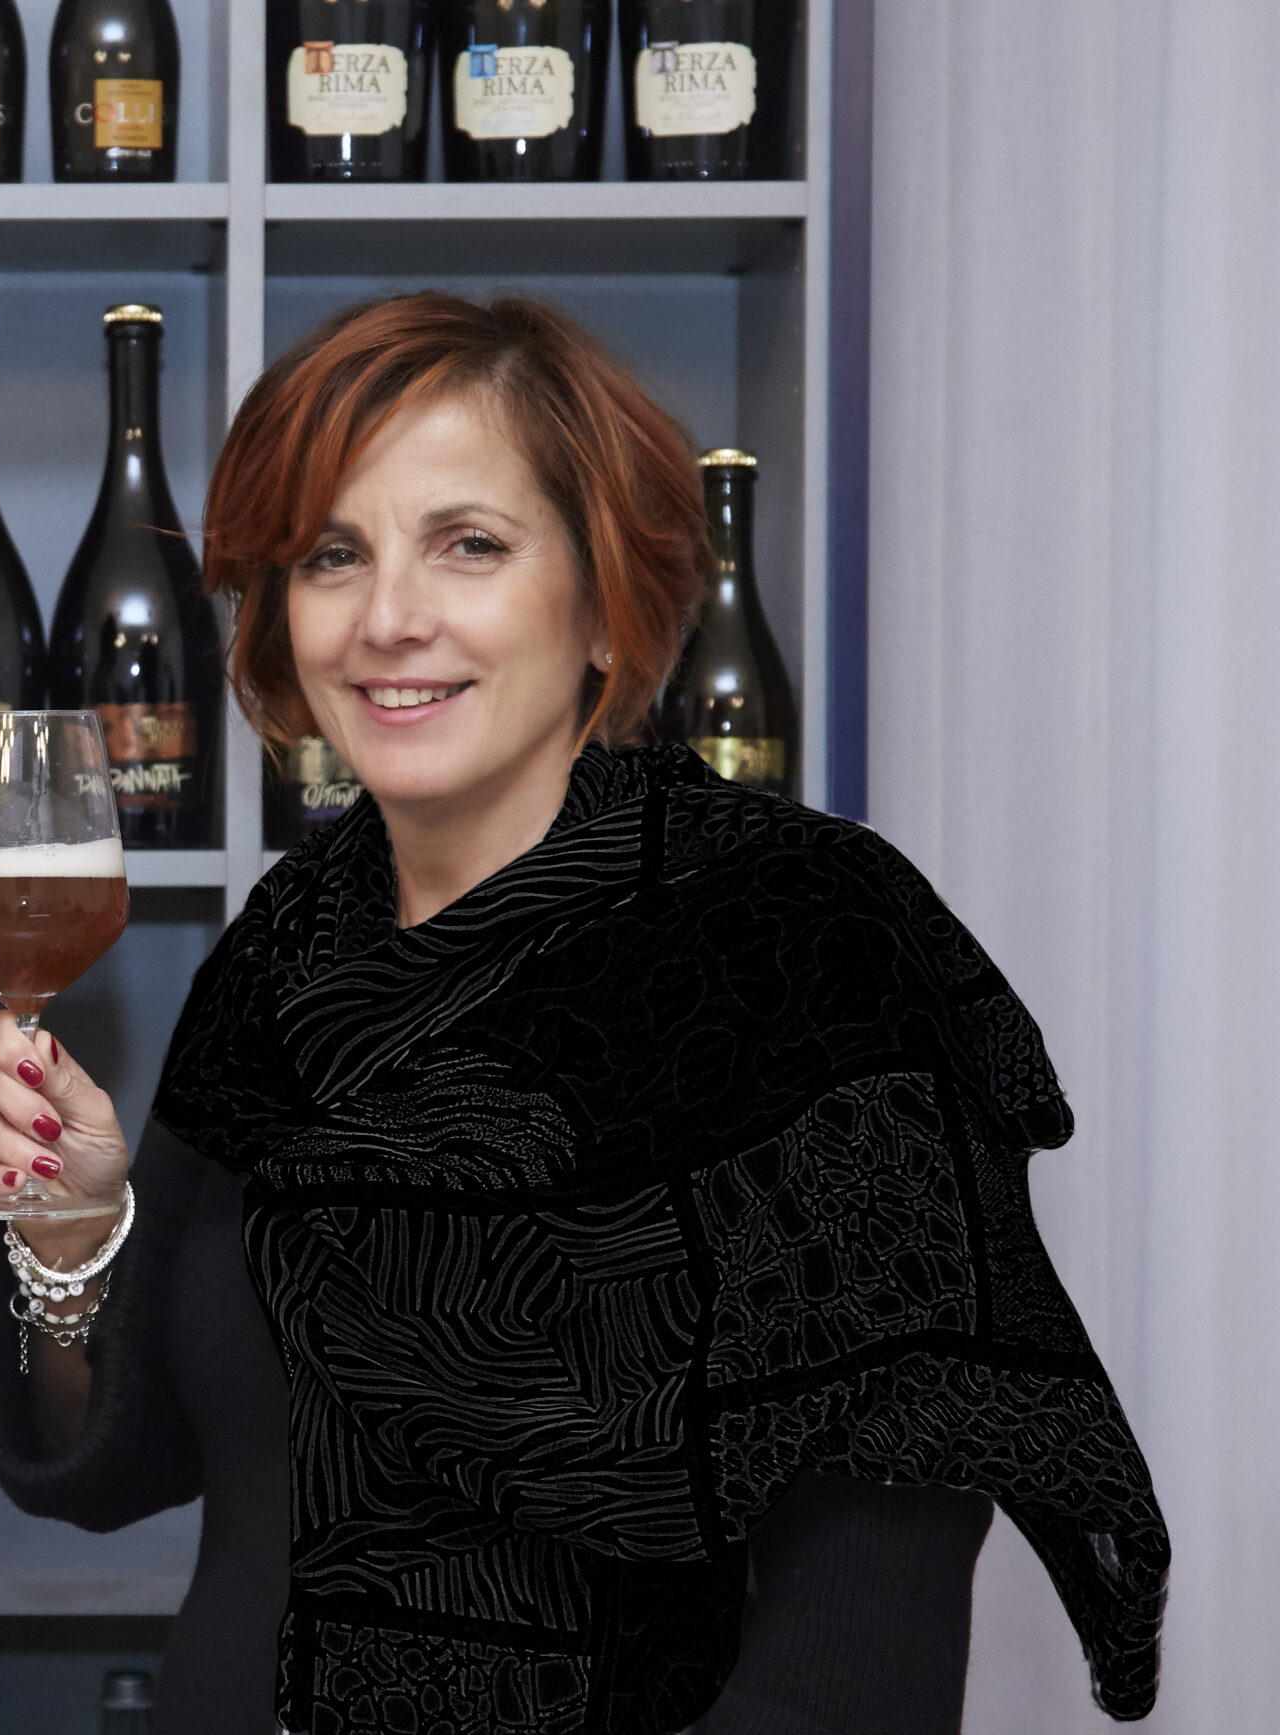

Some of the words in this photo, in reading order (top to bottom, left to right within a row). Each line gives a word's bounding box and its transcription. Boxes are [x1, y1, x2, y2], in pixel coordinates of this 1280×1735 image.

[306, 47, 390, 73] TERZA
[471, 51, 555, 77] TERZA
[653, 47, 736, 73] TERZA
[319, 74, 381, 93] RIMA
[483, 77, 544, 96] RIMA
[664, 73, 727, 93] RIMA
